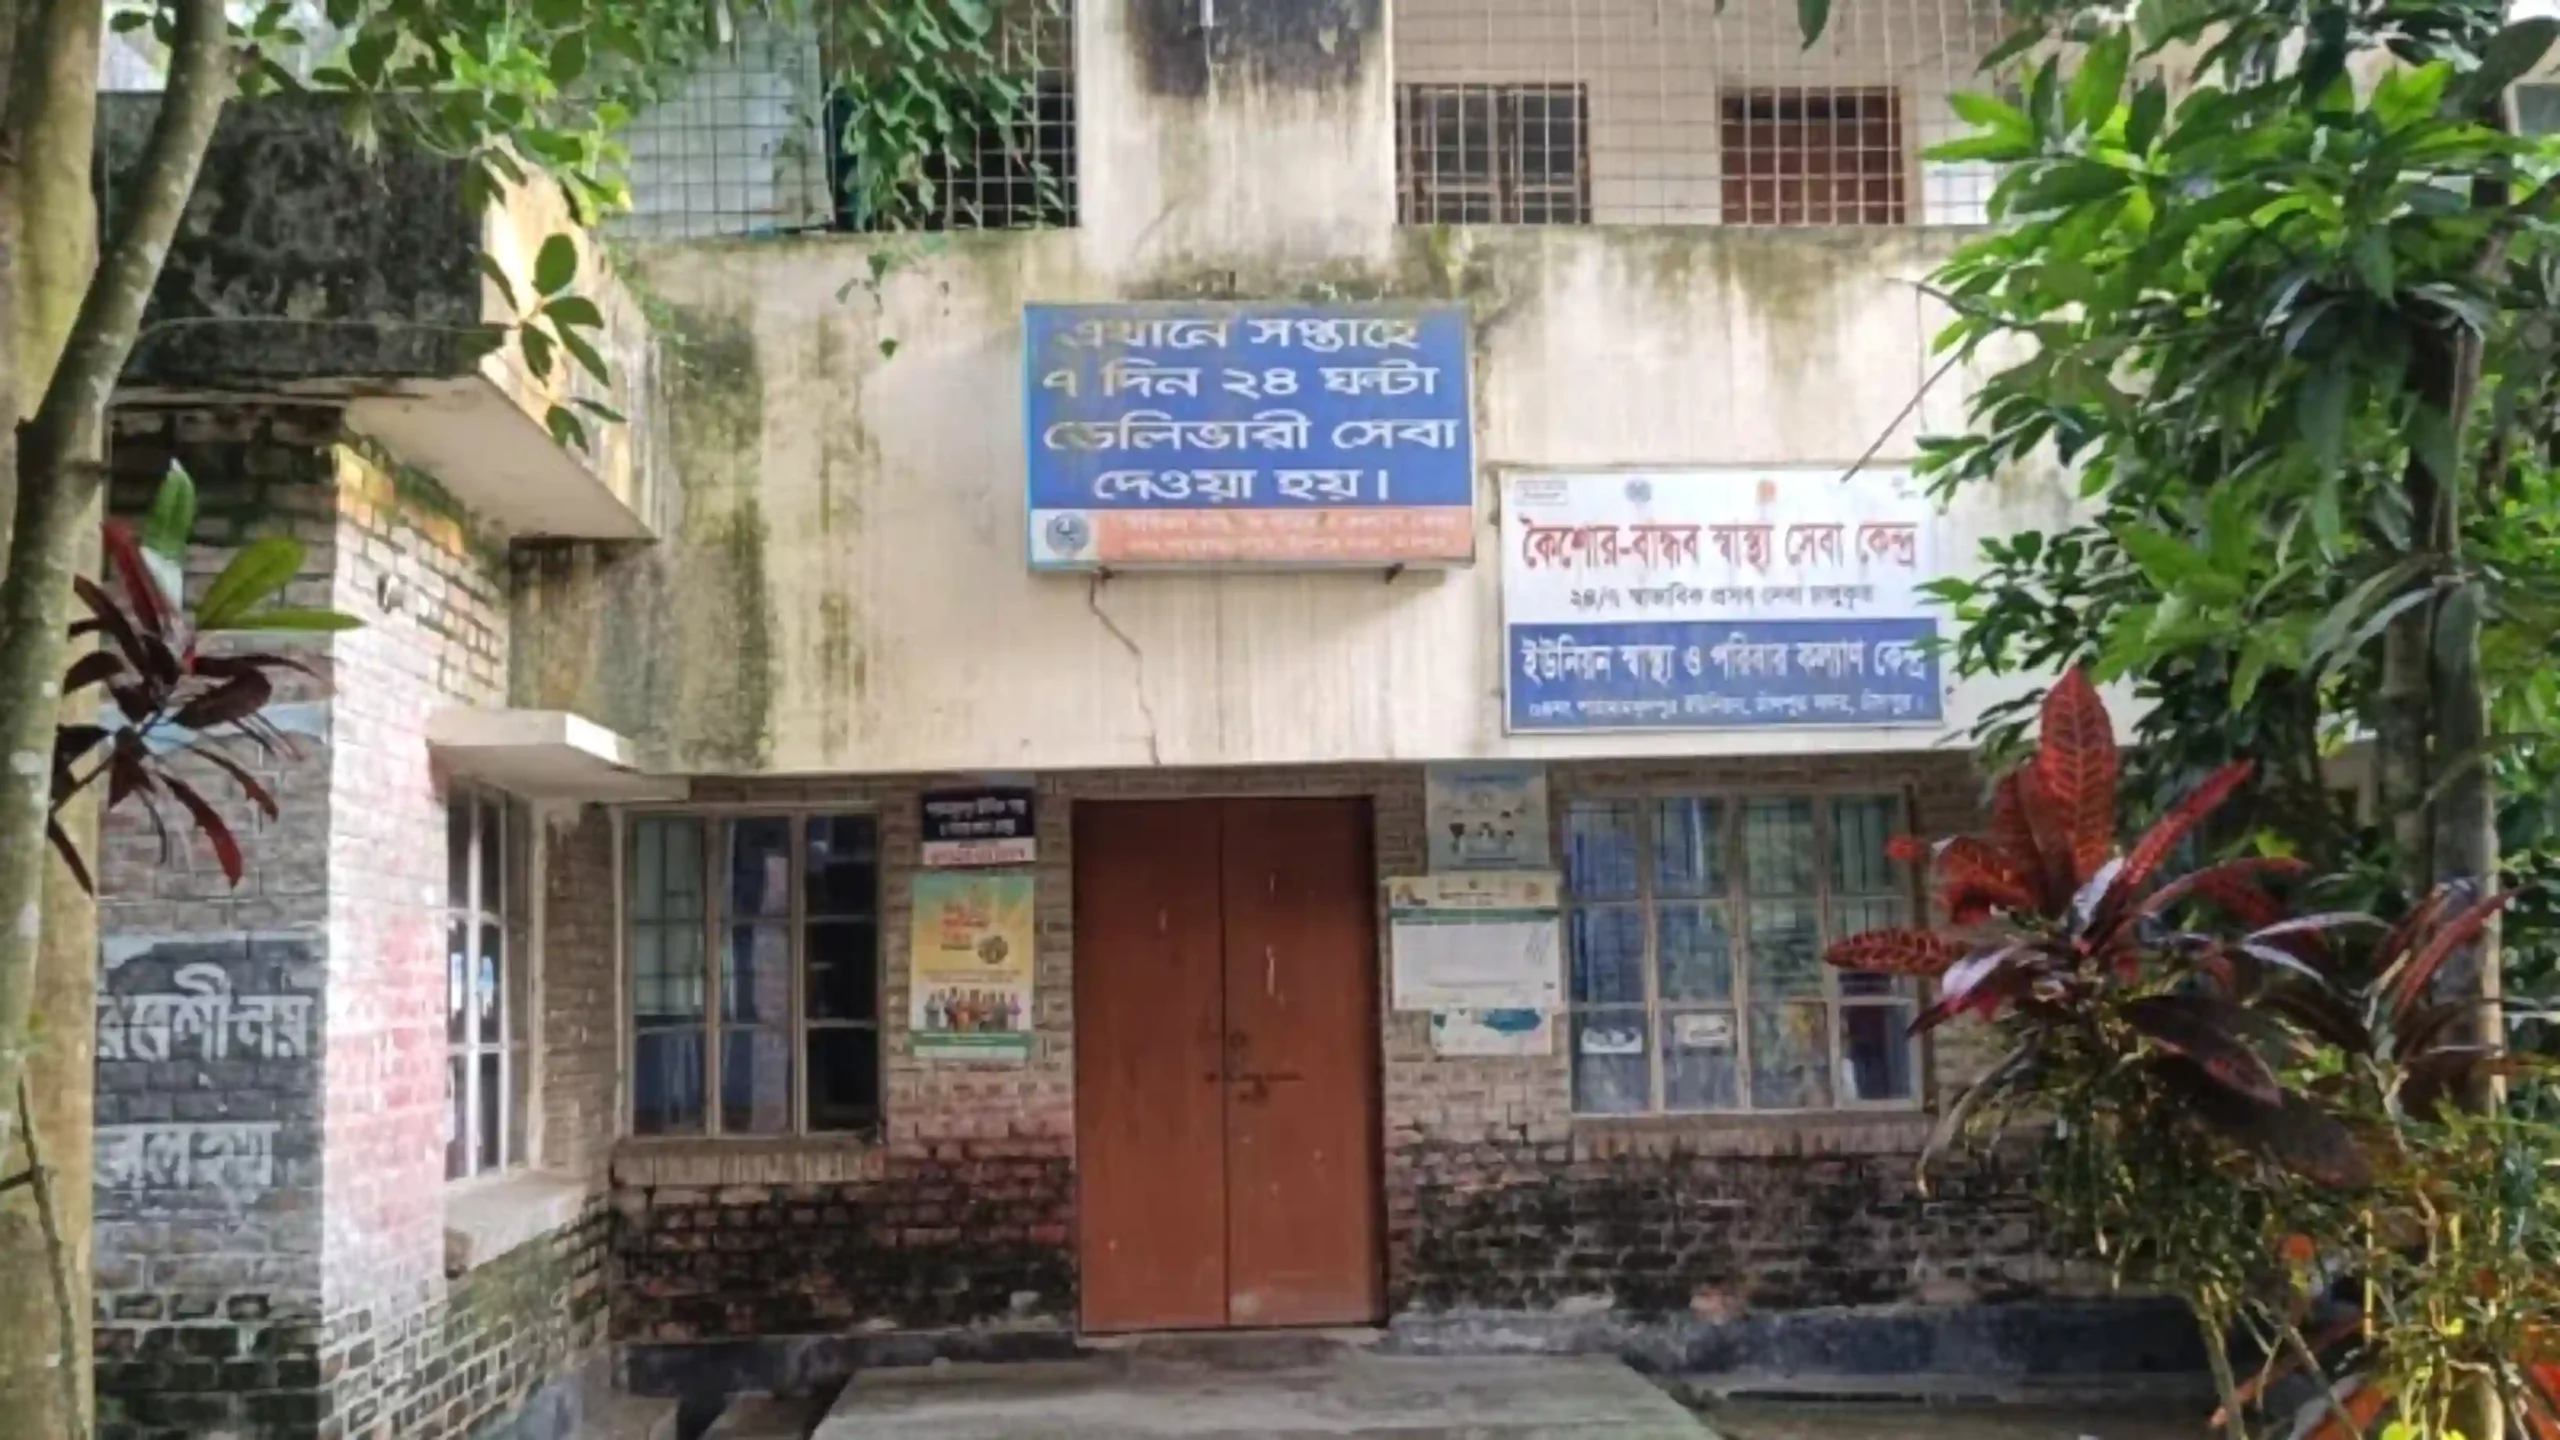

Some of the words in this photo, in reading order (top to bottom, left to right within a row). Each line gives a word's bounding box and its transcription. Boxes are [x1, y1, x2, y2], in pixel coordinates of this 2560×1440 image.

[1053, 318, 1228, 350] এখানে
[1247, 317, 1420, 353] সপ্তাহে
[1043, 369, 1078, 398] ৭
[1102, 356, 1200, 398] দিন
[1222, 366, 1300, 400] ২৪
[1043, 409, 1312, 451] ডেলিভারী
[1331, 418, 1460, 450] সেবা
[1093, 468, 1257, 501] দেওয়া
[1709, 522, 1774, 574] স্বাস্থ্য
[1785, 521, 1845, 568] সেবা
[1856, 521, 1918, 569] কেন্দ্র
[1520, 633, 1611, 688] ইউনিয়ন
[1620, 643, 1676, 685] স্বাস্থ্য
[1683, 645, 1702, 678] ও
[1710, 631, 1789, 680] পরিবার
[1797, 637, 1866, 679] কল্যাণ
[1874, 639, 1927, 681] কেন্দ্র
